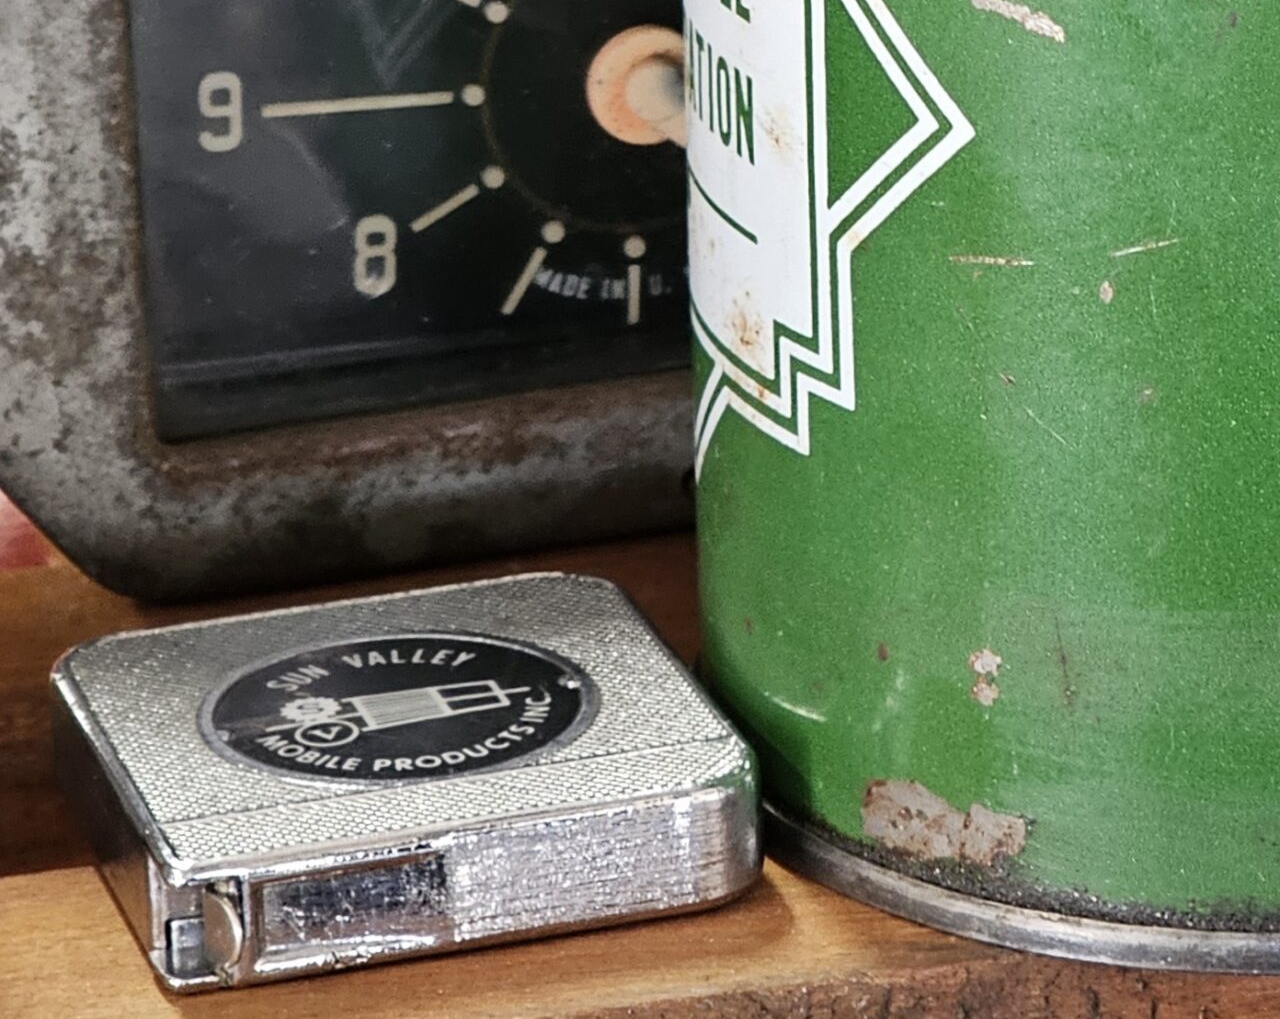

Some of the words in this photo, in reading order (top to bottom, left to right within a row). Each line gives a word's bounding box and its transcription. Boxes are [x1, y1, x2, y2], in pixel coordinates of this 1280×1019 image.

[198, 71, 243, 152] 9
[353, 214, 397, 298] 8
[534, 266, 592, 300] MADE
[600, 277, 628, 300] IN
[266, 664, 330, 693] SUN
[341, 648, 477, 668] VALLEY
[257, 734, 362, 772] MOBILE
[372, 721, 536, 772] PRODUCTS
